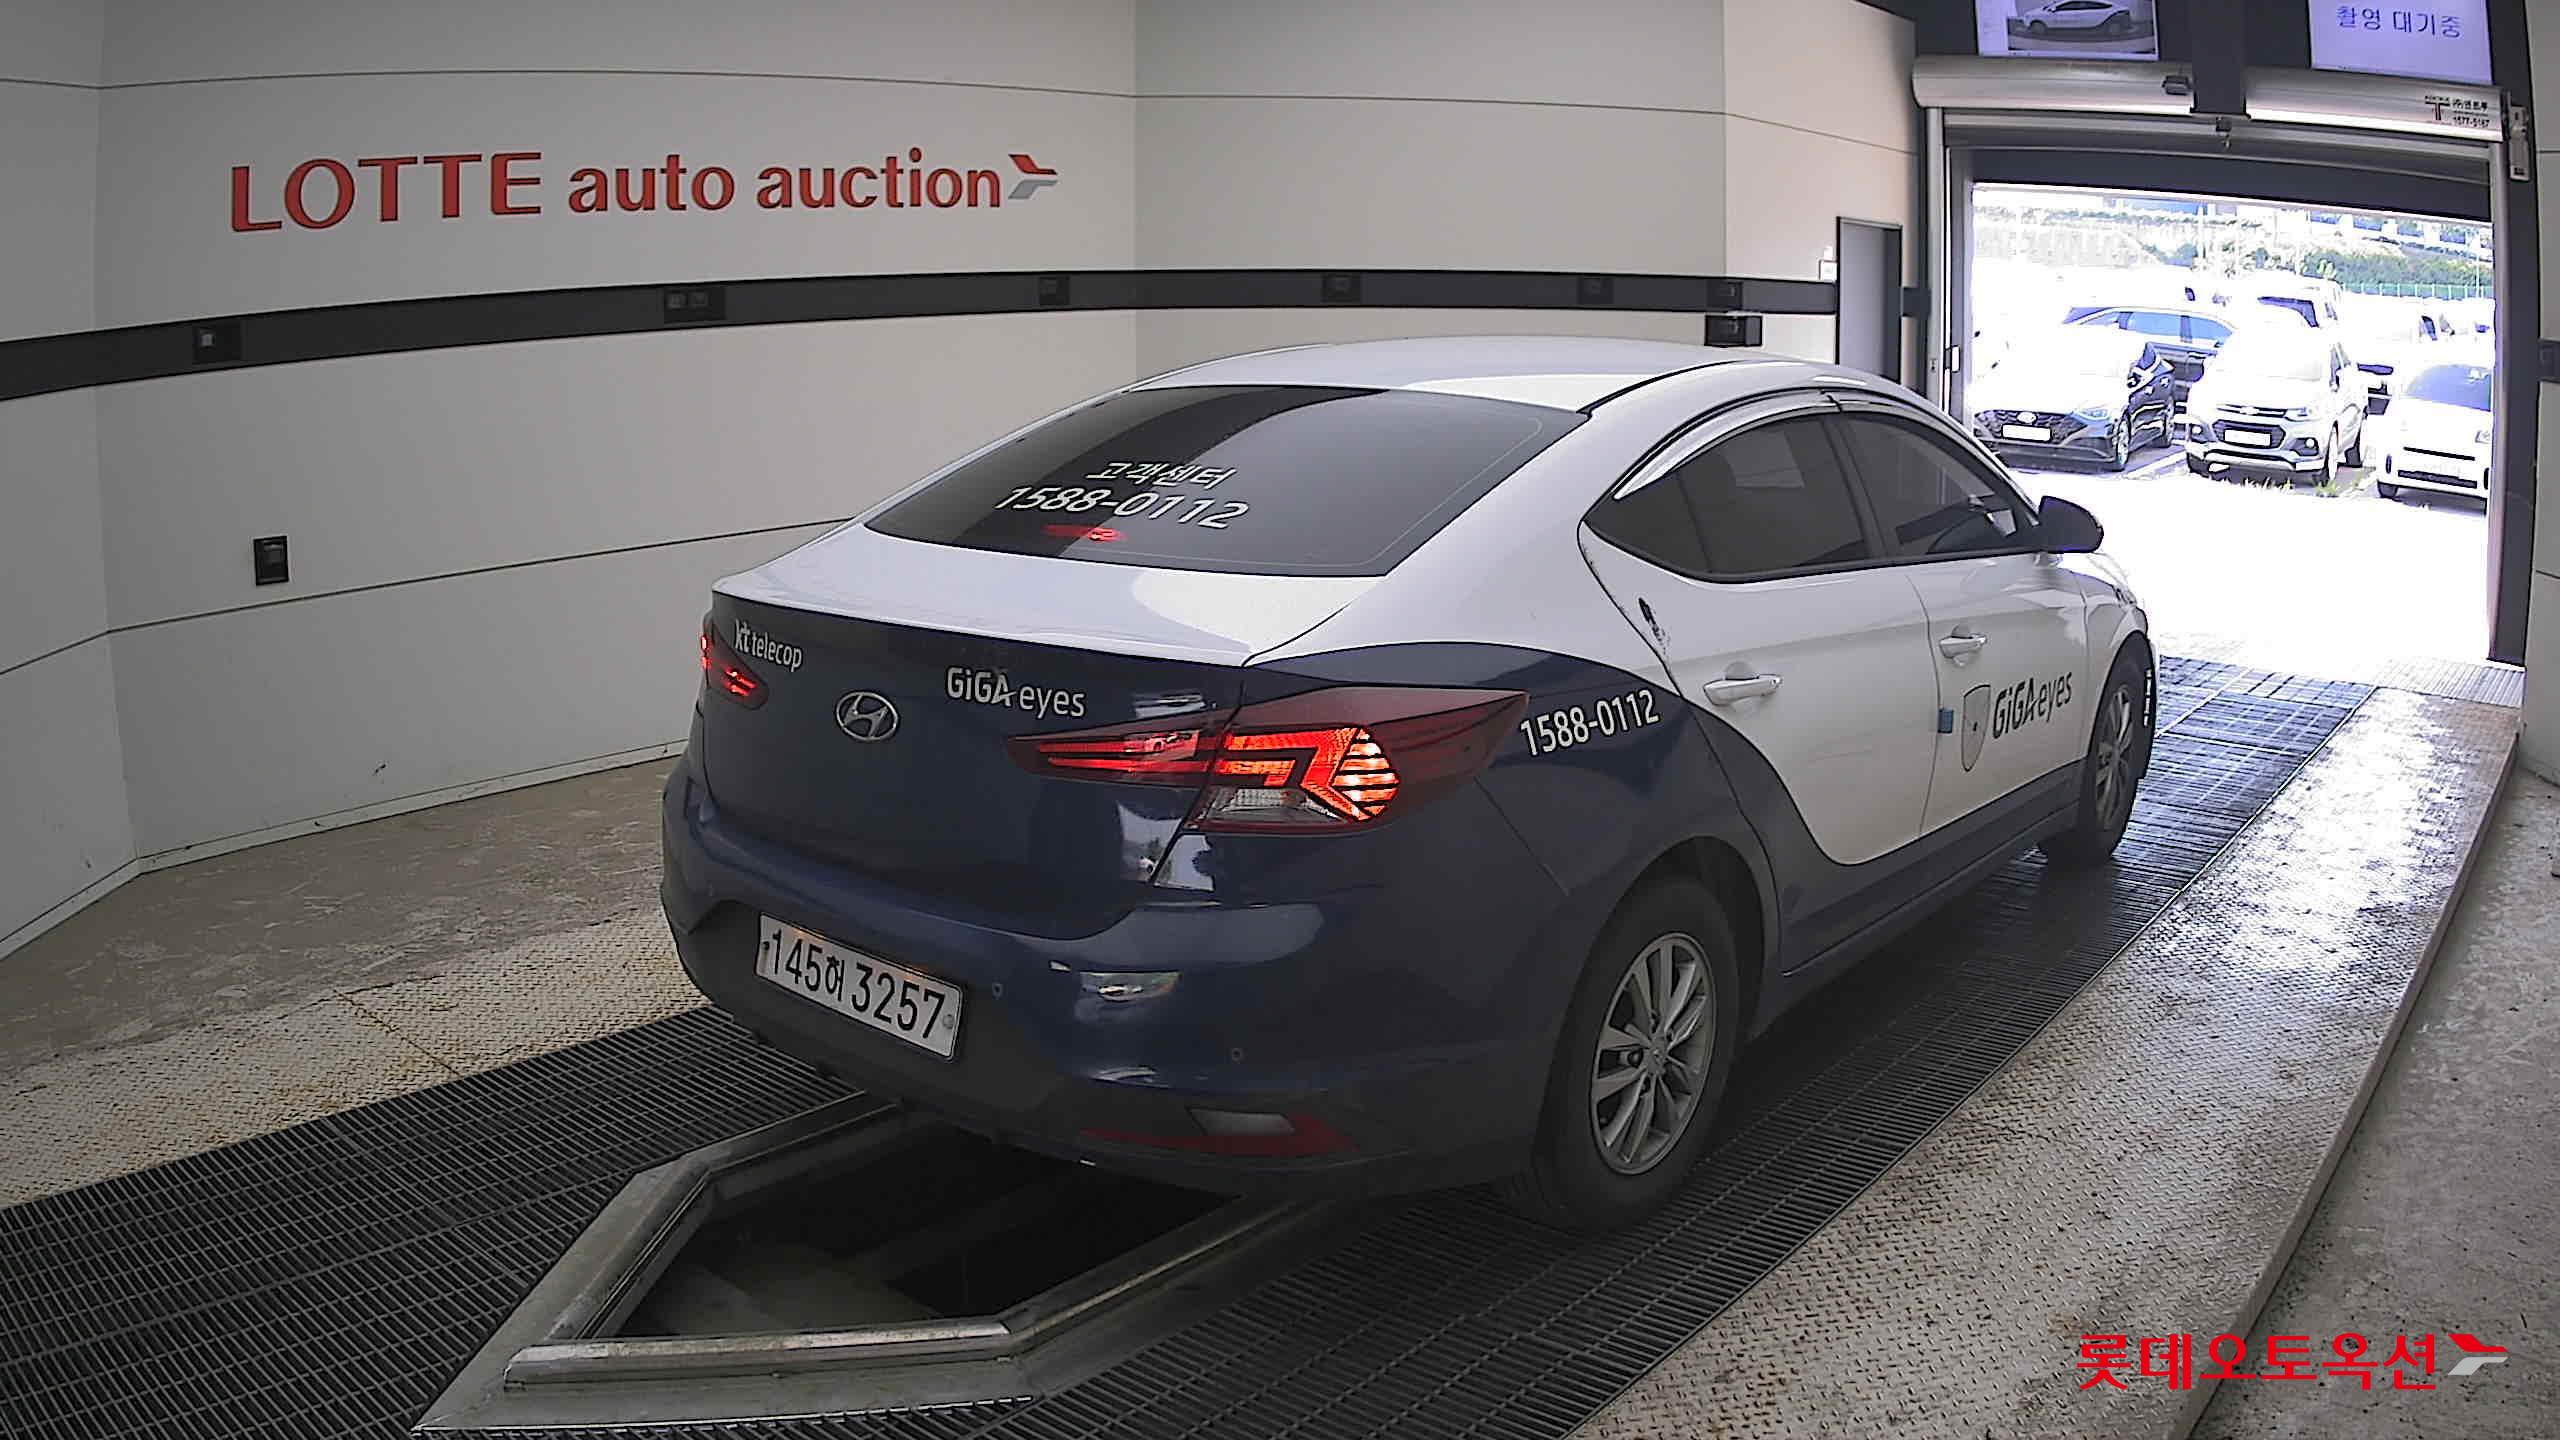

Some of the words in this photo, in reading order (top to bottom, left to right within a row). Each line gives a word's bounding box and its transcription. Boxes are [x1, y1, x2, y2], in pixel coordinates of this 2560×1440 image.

[2393, 11, 2461, 38] 대기중
[230, 151, 542, 233] LOTTE
[568, 152, 736, 213] auto
[756, 146, 1001, 209] auction
[1087, 462, 1236, 489] 고객센터
[995, 486, 1249, 528] 1588-0112
[735, 619, 750, 653] kt
[752, 631, 802, 673] telecop
[1019, 685, 1085, 719] eyes
[1520, 689, 1660, 756] 1588-0112
[2037, 671, 2073, 723] eyes
[851, 962, 945, 1039] 3257
